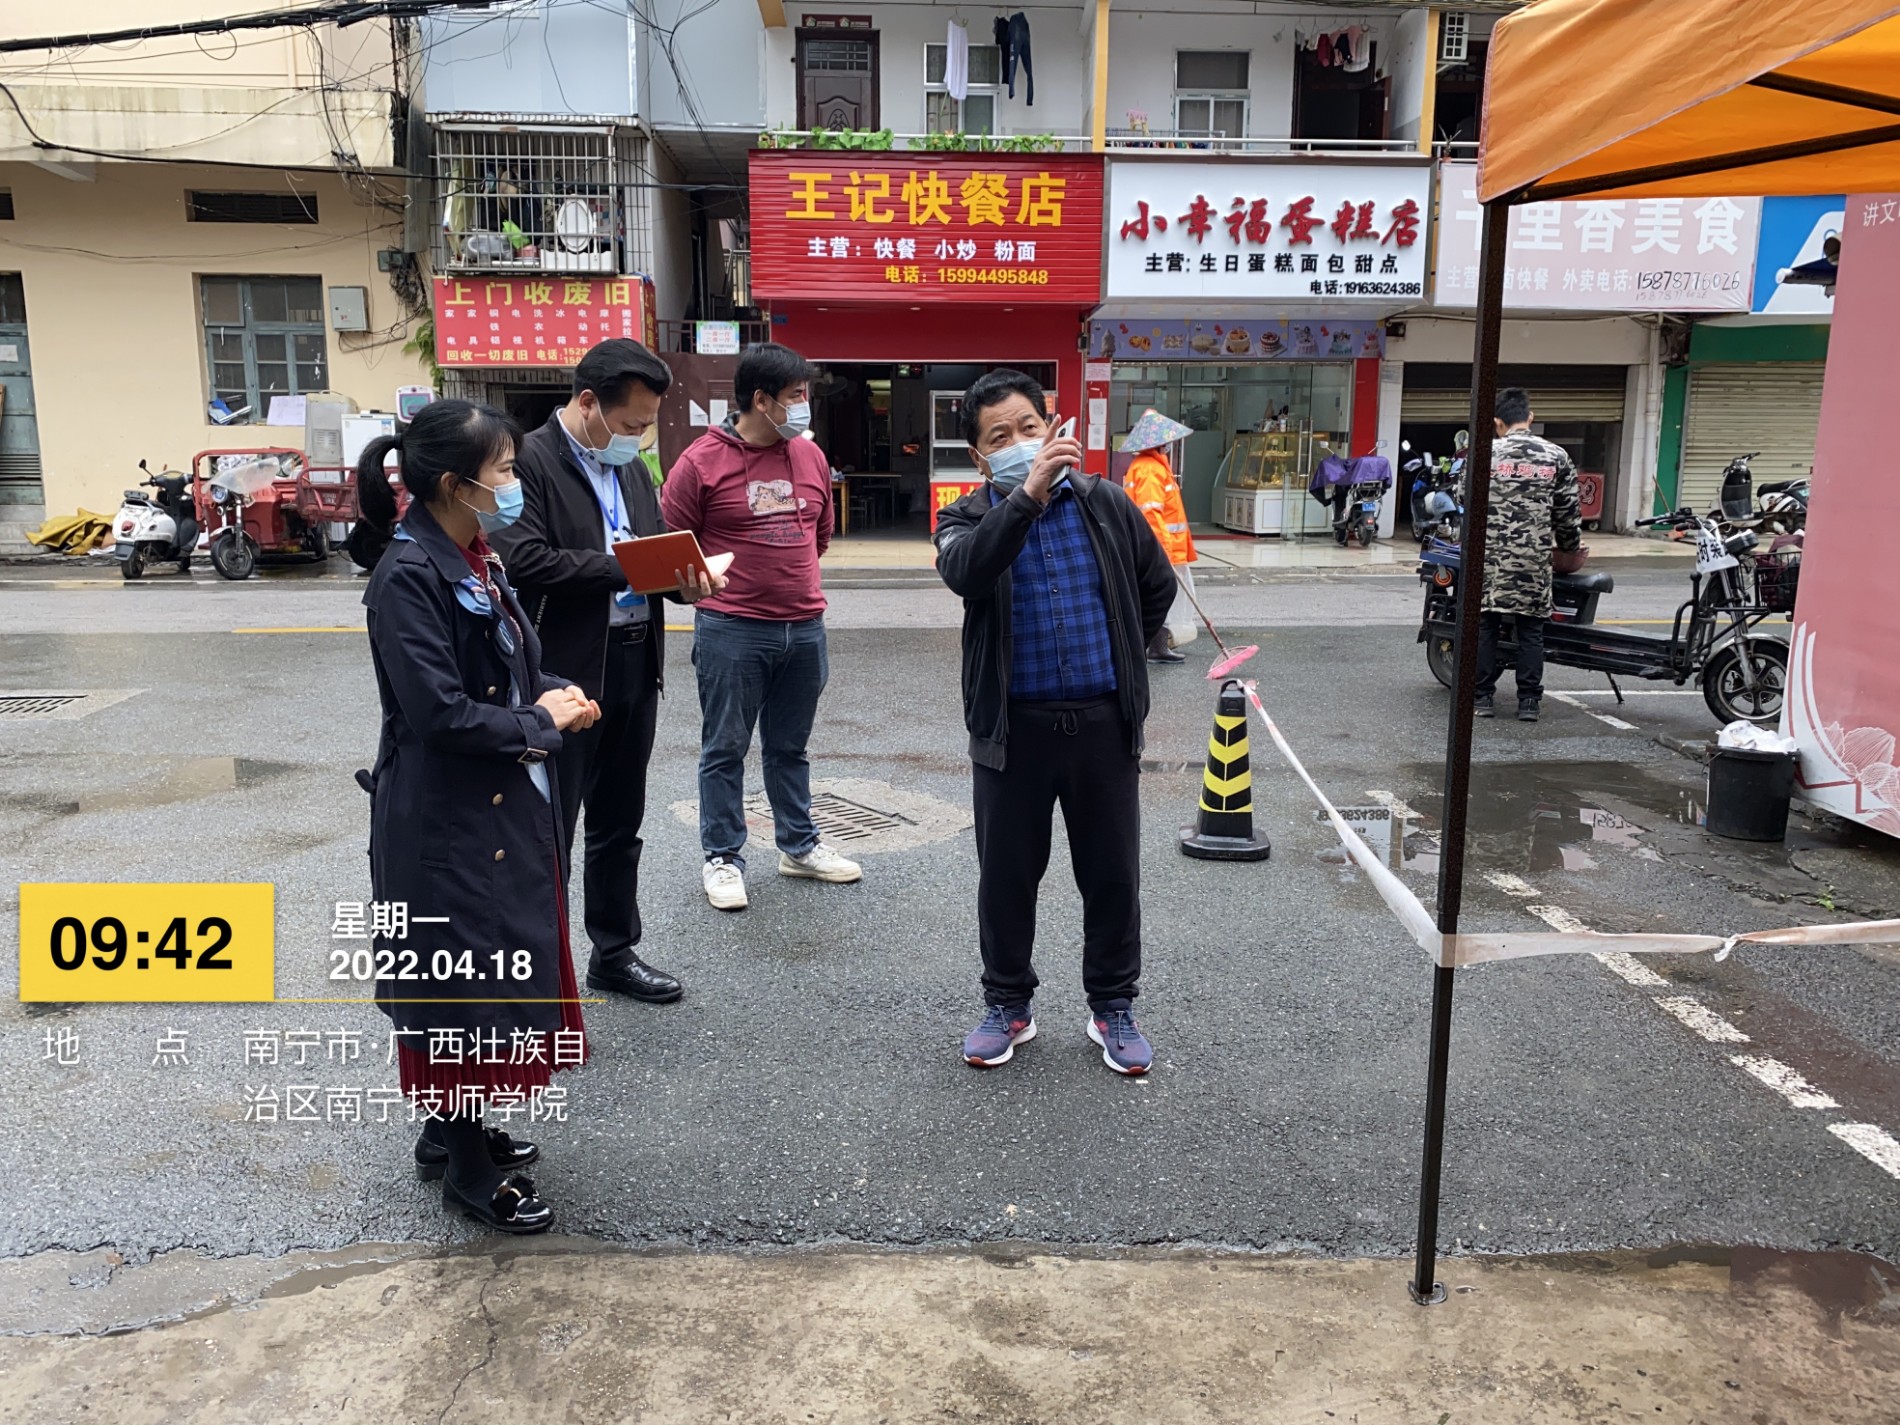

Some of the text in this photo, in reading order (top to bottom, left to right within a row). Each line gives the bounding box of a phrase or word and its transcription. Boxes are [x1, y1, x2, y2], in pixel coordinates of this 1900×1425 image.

[785, 170, 1067, 227] 王记快餐店
[1120, 194, 1420, 248] 小幸福蛋糕店
[1862, 199, 1900, 227] 讲文
[934, 239, 977, 261] 小炒
[994, 240, 1037, 262] 粉面
[1637, 270, 1740, 291] 15878776026
[445, 281, 630, 306] 上门收废旧
[447, 349, 528, 361] 回收一切废旧
[563, 347, 591, 356] 1529
